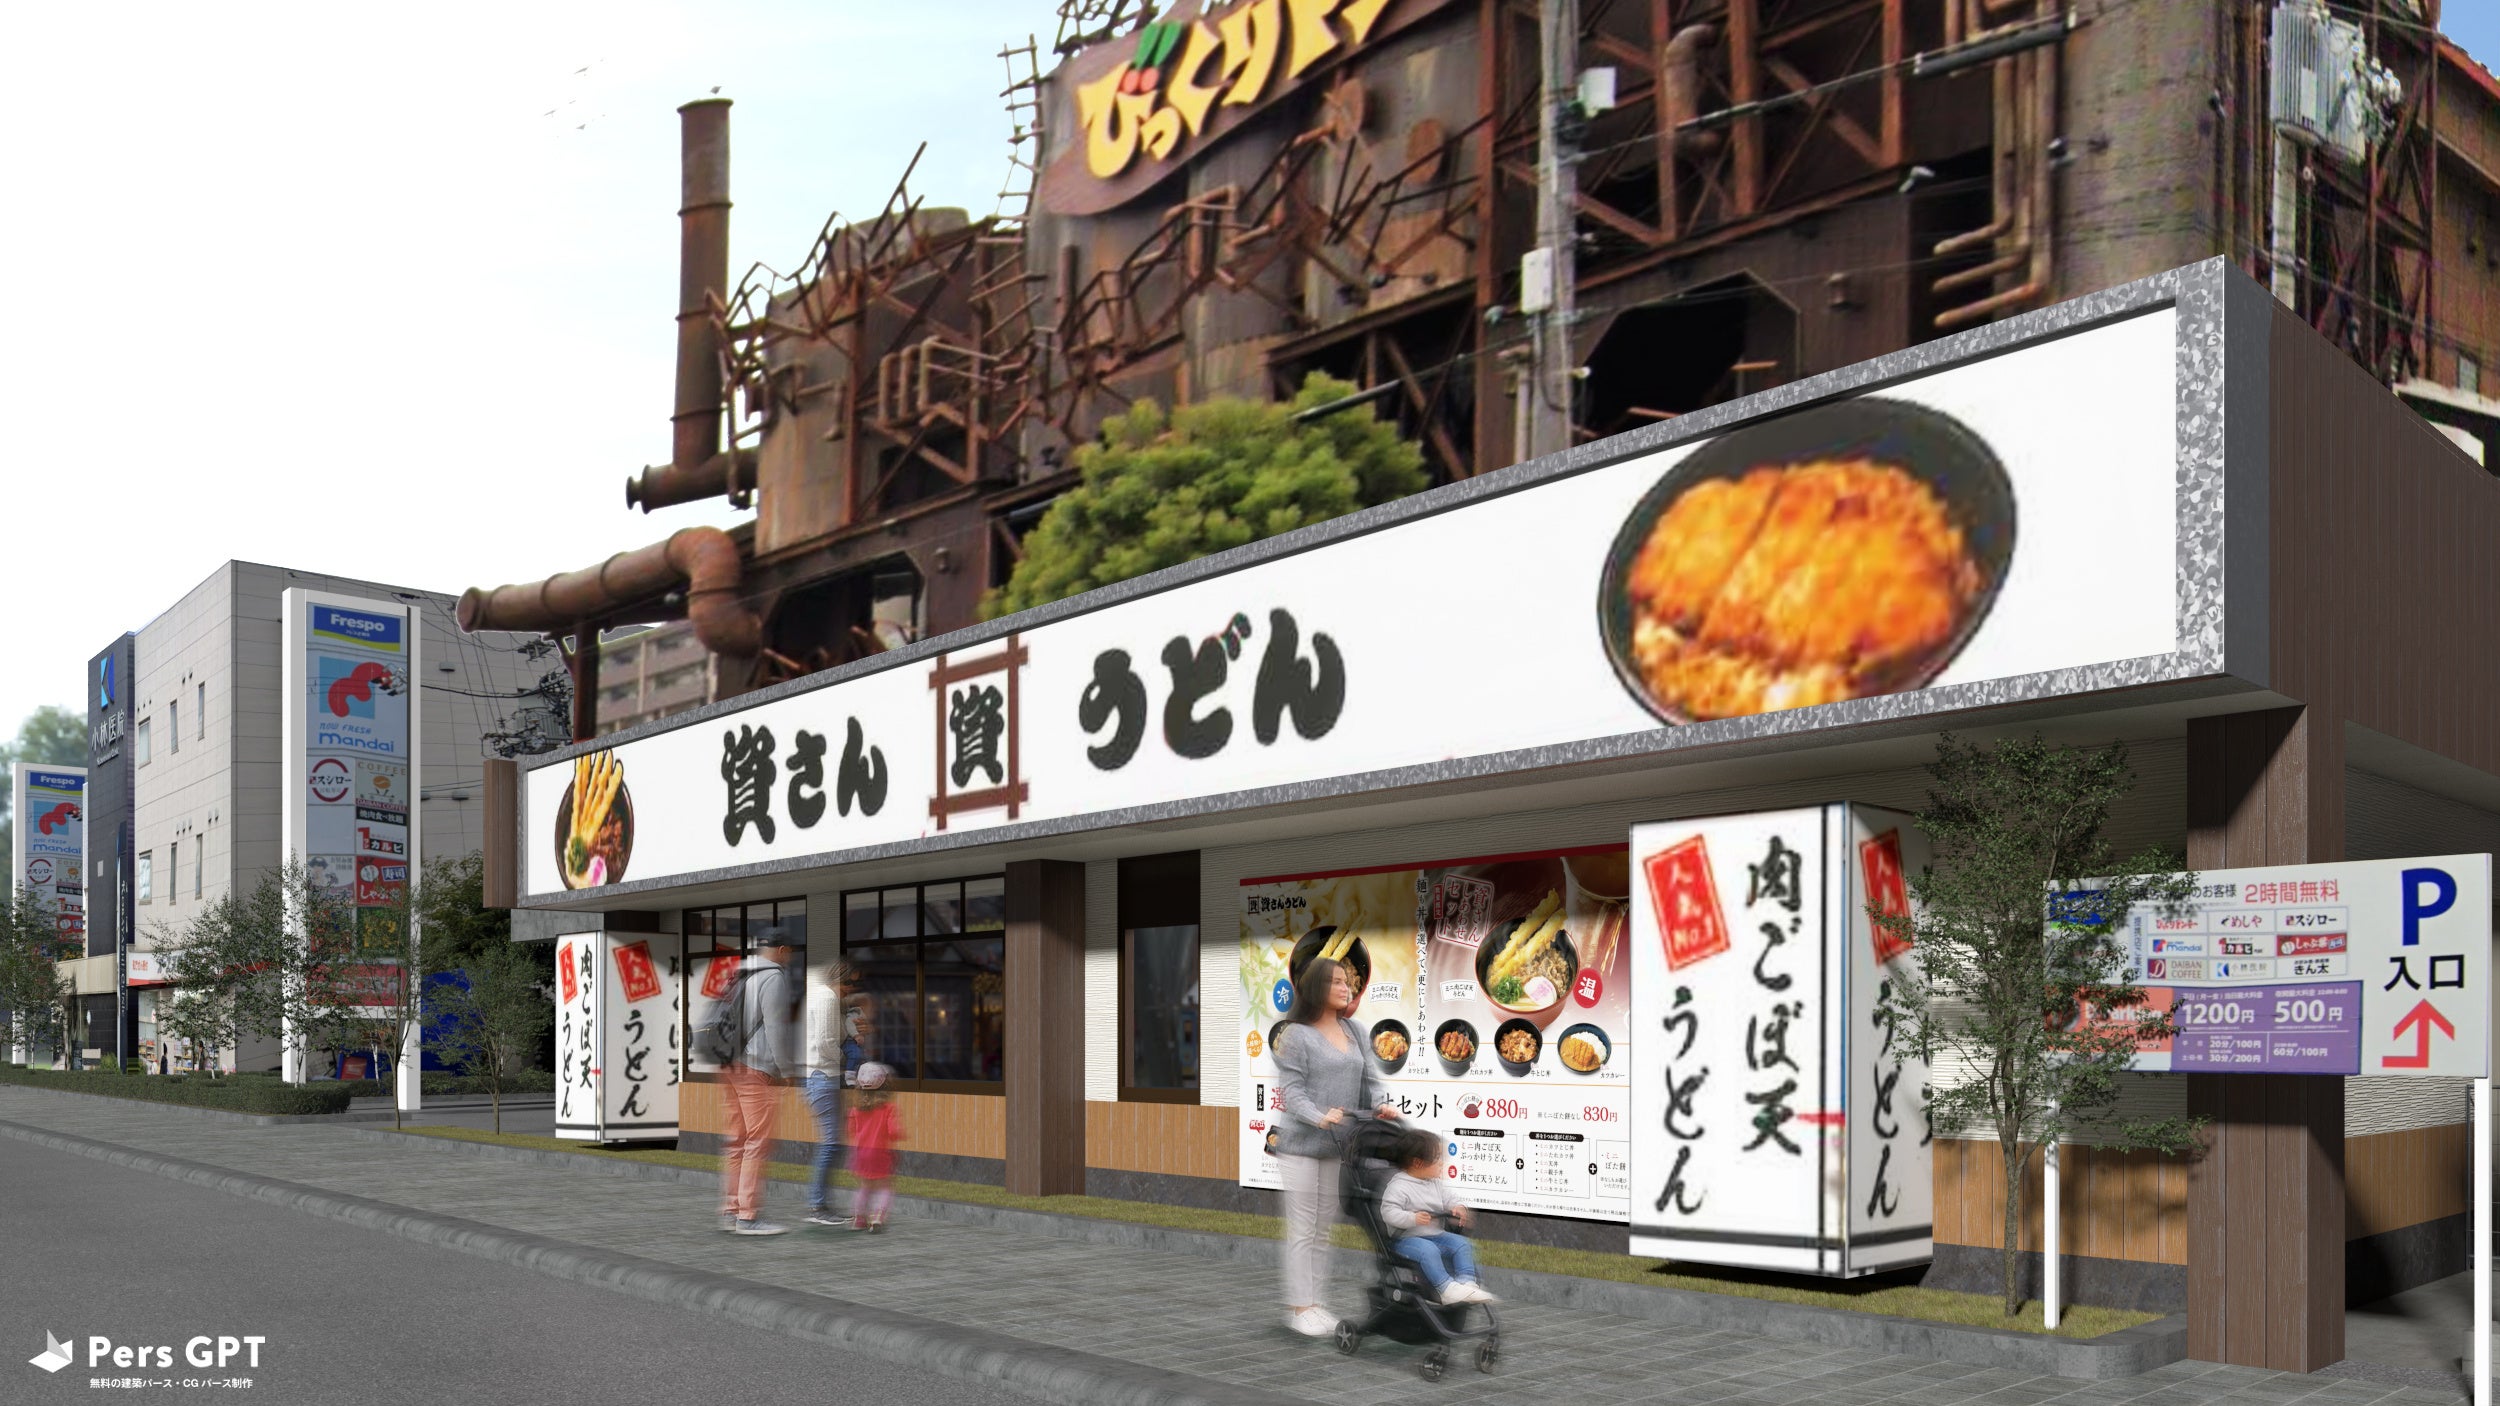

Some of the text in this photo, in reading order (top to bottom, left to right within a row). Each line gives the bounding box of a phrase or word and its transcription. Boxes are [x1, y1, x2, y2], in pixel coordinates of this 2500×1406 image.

[330, 613, 385, 632] Frespo
[91, 709, 124, 751] 小林医院
[721, 608, 1346, 847] 資さん 資 うどん
[319, 732, 394, 752] mandai
[357, 761, 407, 776] COFFEE
[40, 775, 76, 786] Frespo
[317, 775, 352, 785] スシロー
[33, 843, 81, 854] mandai
[370, 839, 403, 854] カルビ
[2245, 879, 2340, 904] 2時間無料
[1261, 896, 1307, 912] 資さんうどん
[1443, 880, 1460, 935] セット
[1455, 881, 1471, 940] しあわせ
[2401, 867, 2458, 946] P
[1469, 887, 1488, 943] 資さん
[2231, 915, 2262, 928] めしや
[2295, 914, 2337, 926] スシロー
[2171, 960, 2202, 969] DAIBAN
[2171, 970, 2202, 979] COFFEE
[2294, 964, 2329, 975] きん太
[2384, 954, 2465, 992] 入口
[1276, 986, 1290, 1005] 冷
[1578, 976, 1597, 1001] 温
[2182, 1002, 2255, 1024] 1200円
[2274, 999, 2343, 1023] 500円
[561, 1011, 574, 1118] うどん
[619, 1009, 650, 1117] うどん
[1486, 1098, 1528, 1120] 880円
[1583, 1106, 1618, 1122] 830円
[1655, 985, 1709, 1215] うどん
[1460, 1152, 1507, 1163] ぶっかけうどん
[1460, 1173, 1508, 1185] 肉ごぼ天うどん
